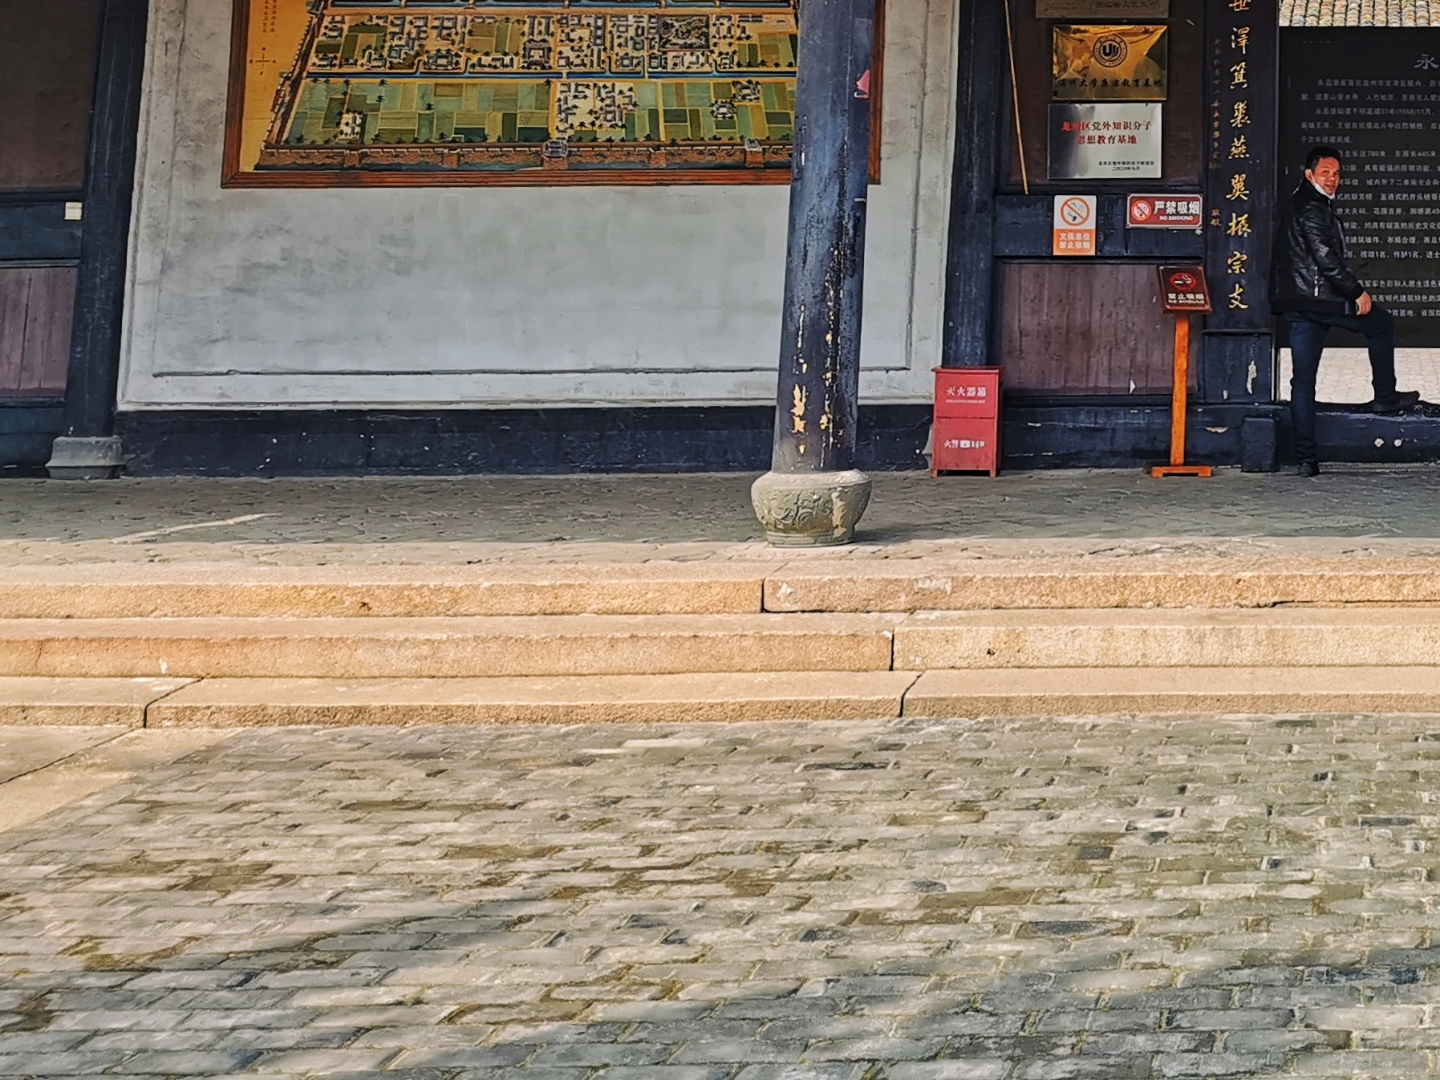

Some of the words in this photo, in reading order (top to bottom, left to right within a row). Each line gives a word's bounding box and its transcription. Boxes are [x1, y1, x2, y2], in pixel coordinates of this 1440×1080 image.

[1076, 134, 1138, 145] 思想教育基地
[1153, 200, 1200, 216] 严禁吸烟
[1059, 240, 1091, 250] 禁止吸烟
[1167, 293, 1205, 301] 禁止吸烟
[945, 386, 987, 398] 灭火器箱
